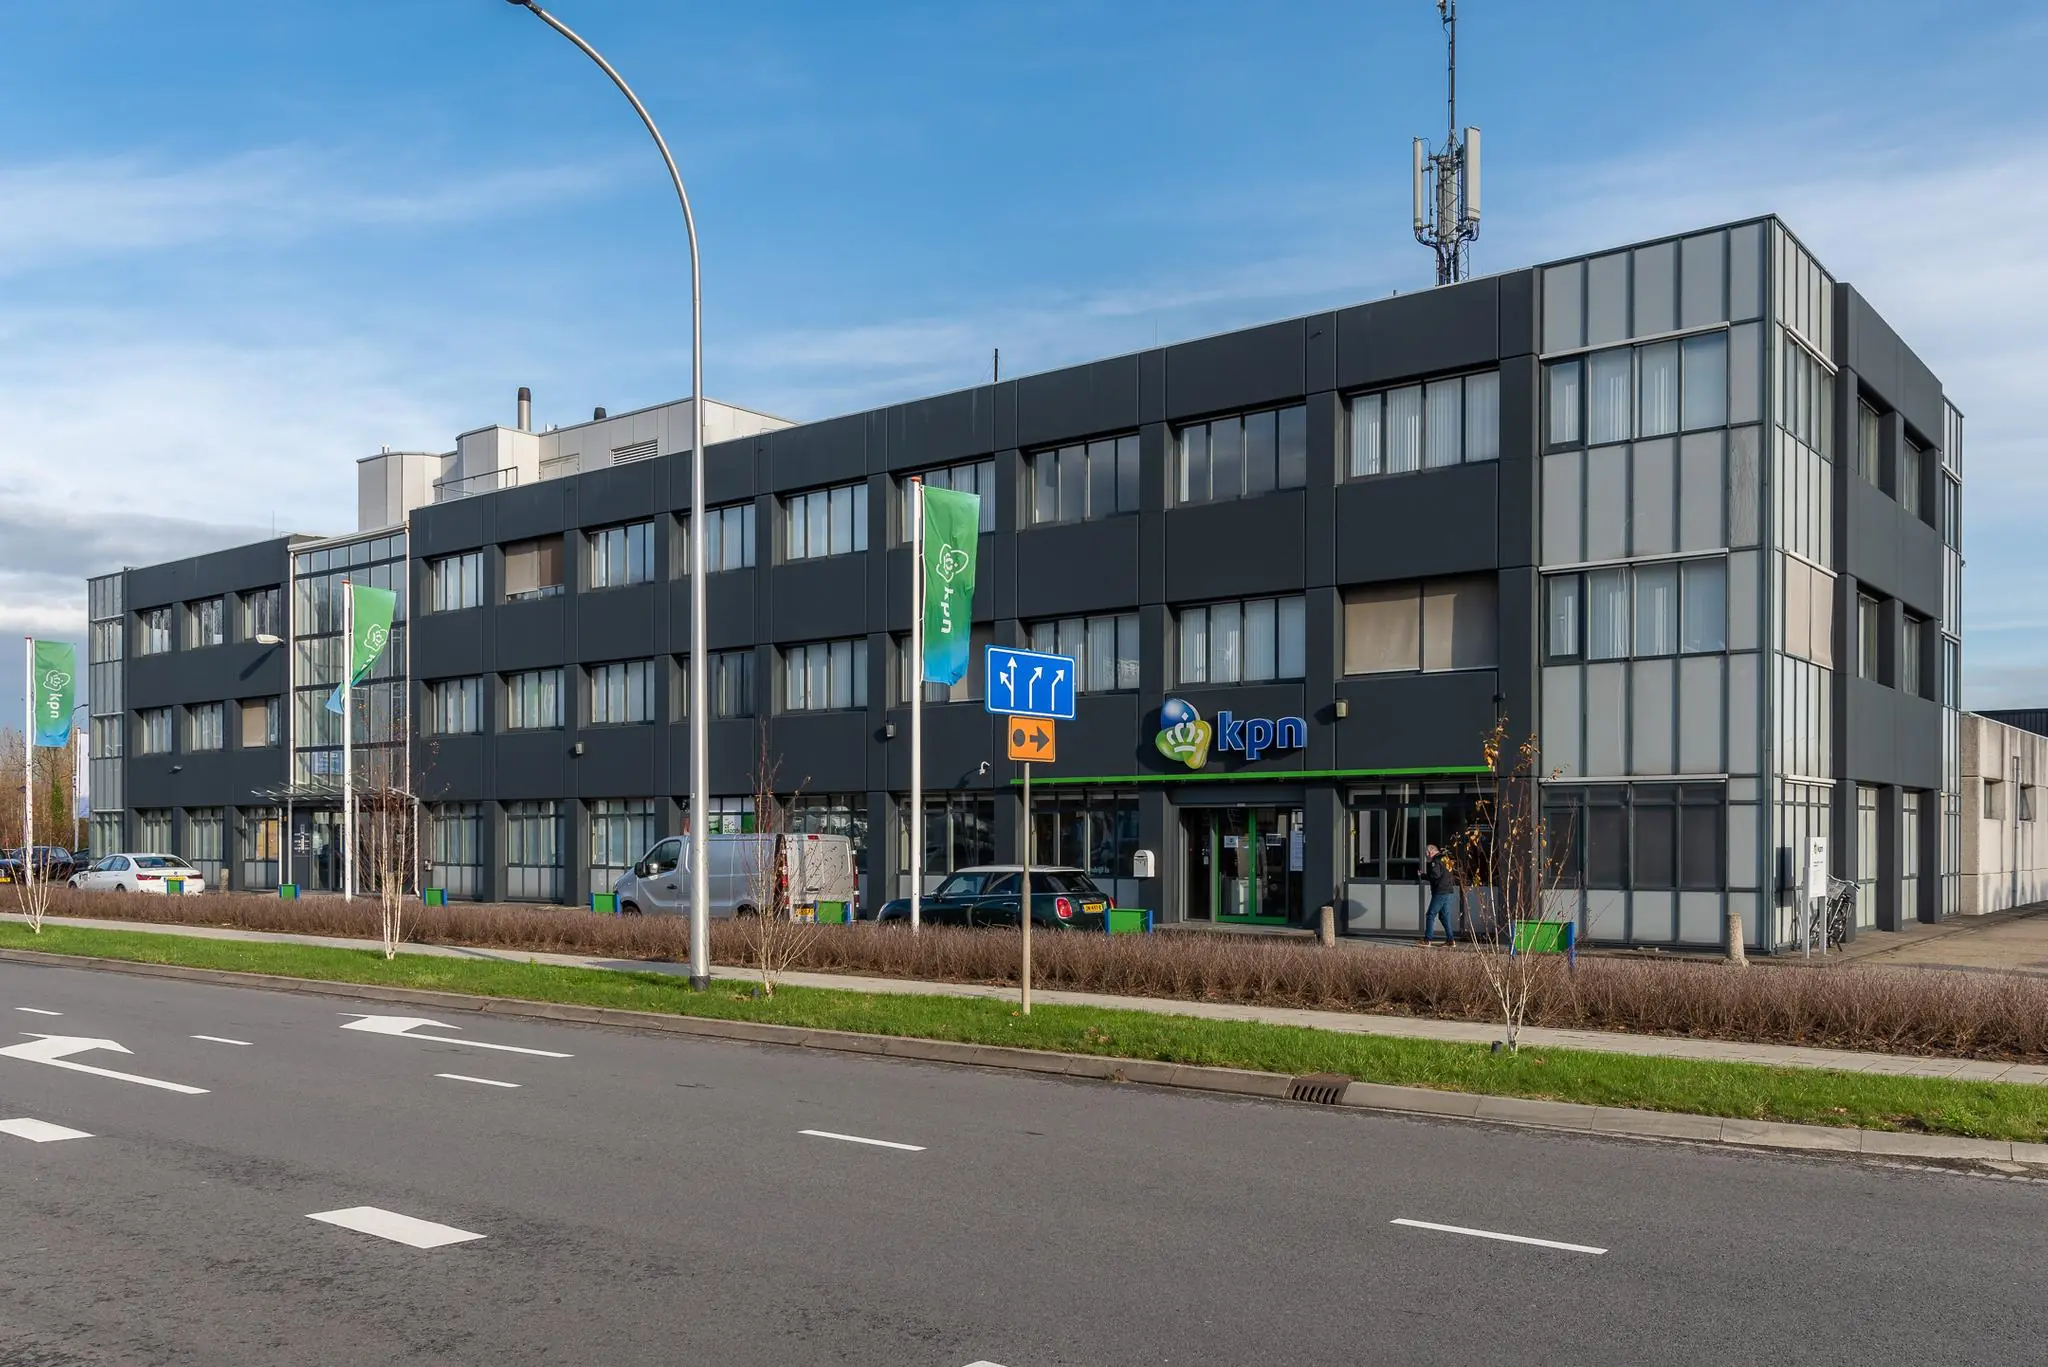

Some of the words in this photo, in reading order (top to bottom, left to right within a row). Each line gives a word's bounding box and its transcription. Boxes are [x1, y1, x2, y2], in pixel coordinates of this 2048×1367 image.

[941, 586, 954, 634] kpn
[46, 693, 63, 718] kpn
[1217, 710, 1308, 761] kpn
